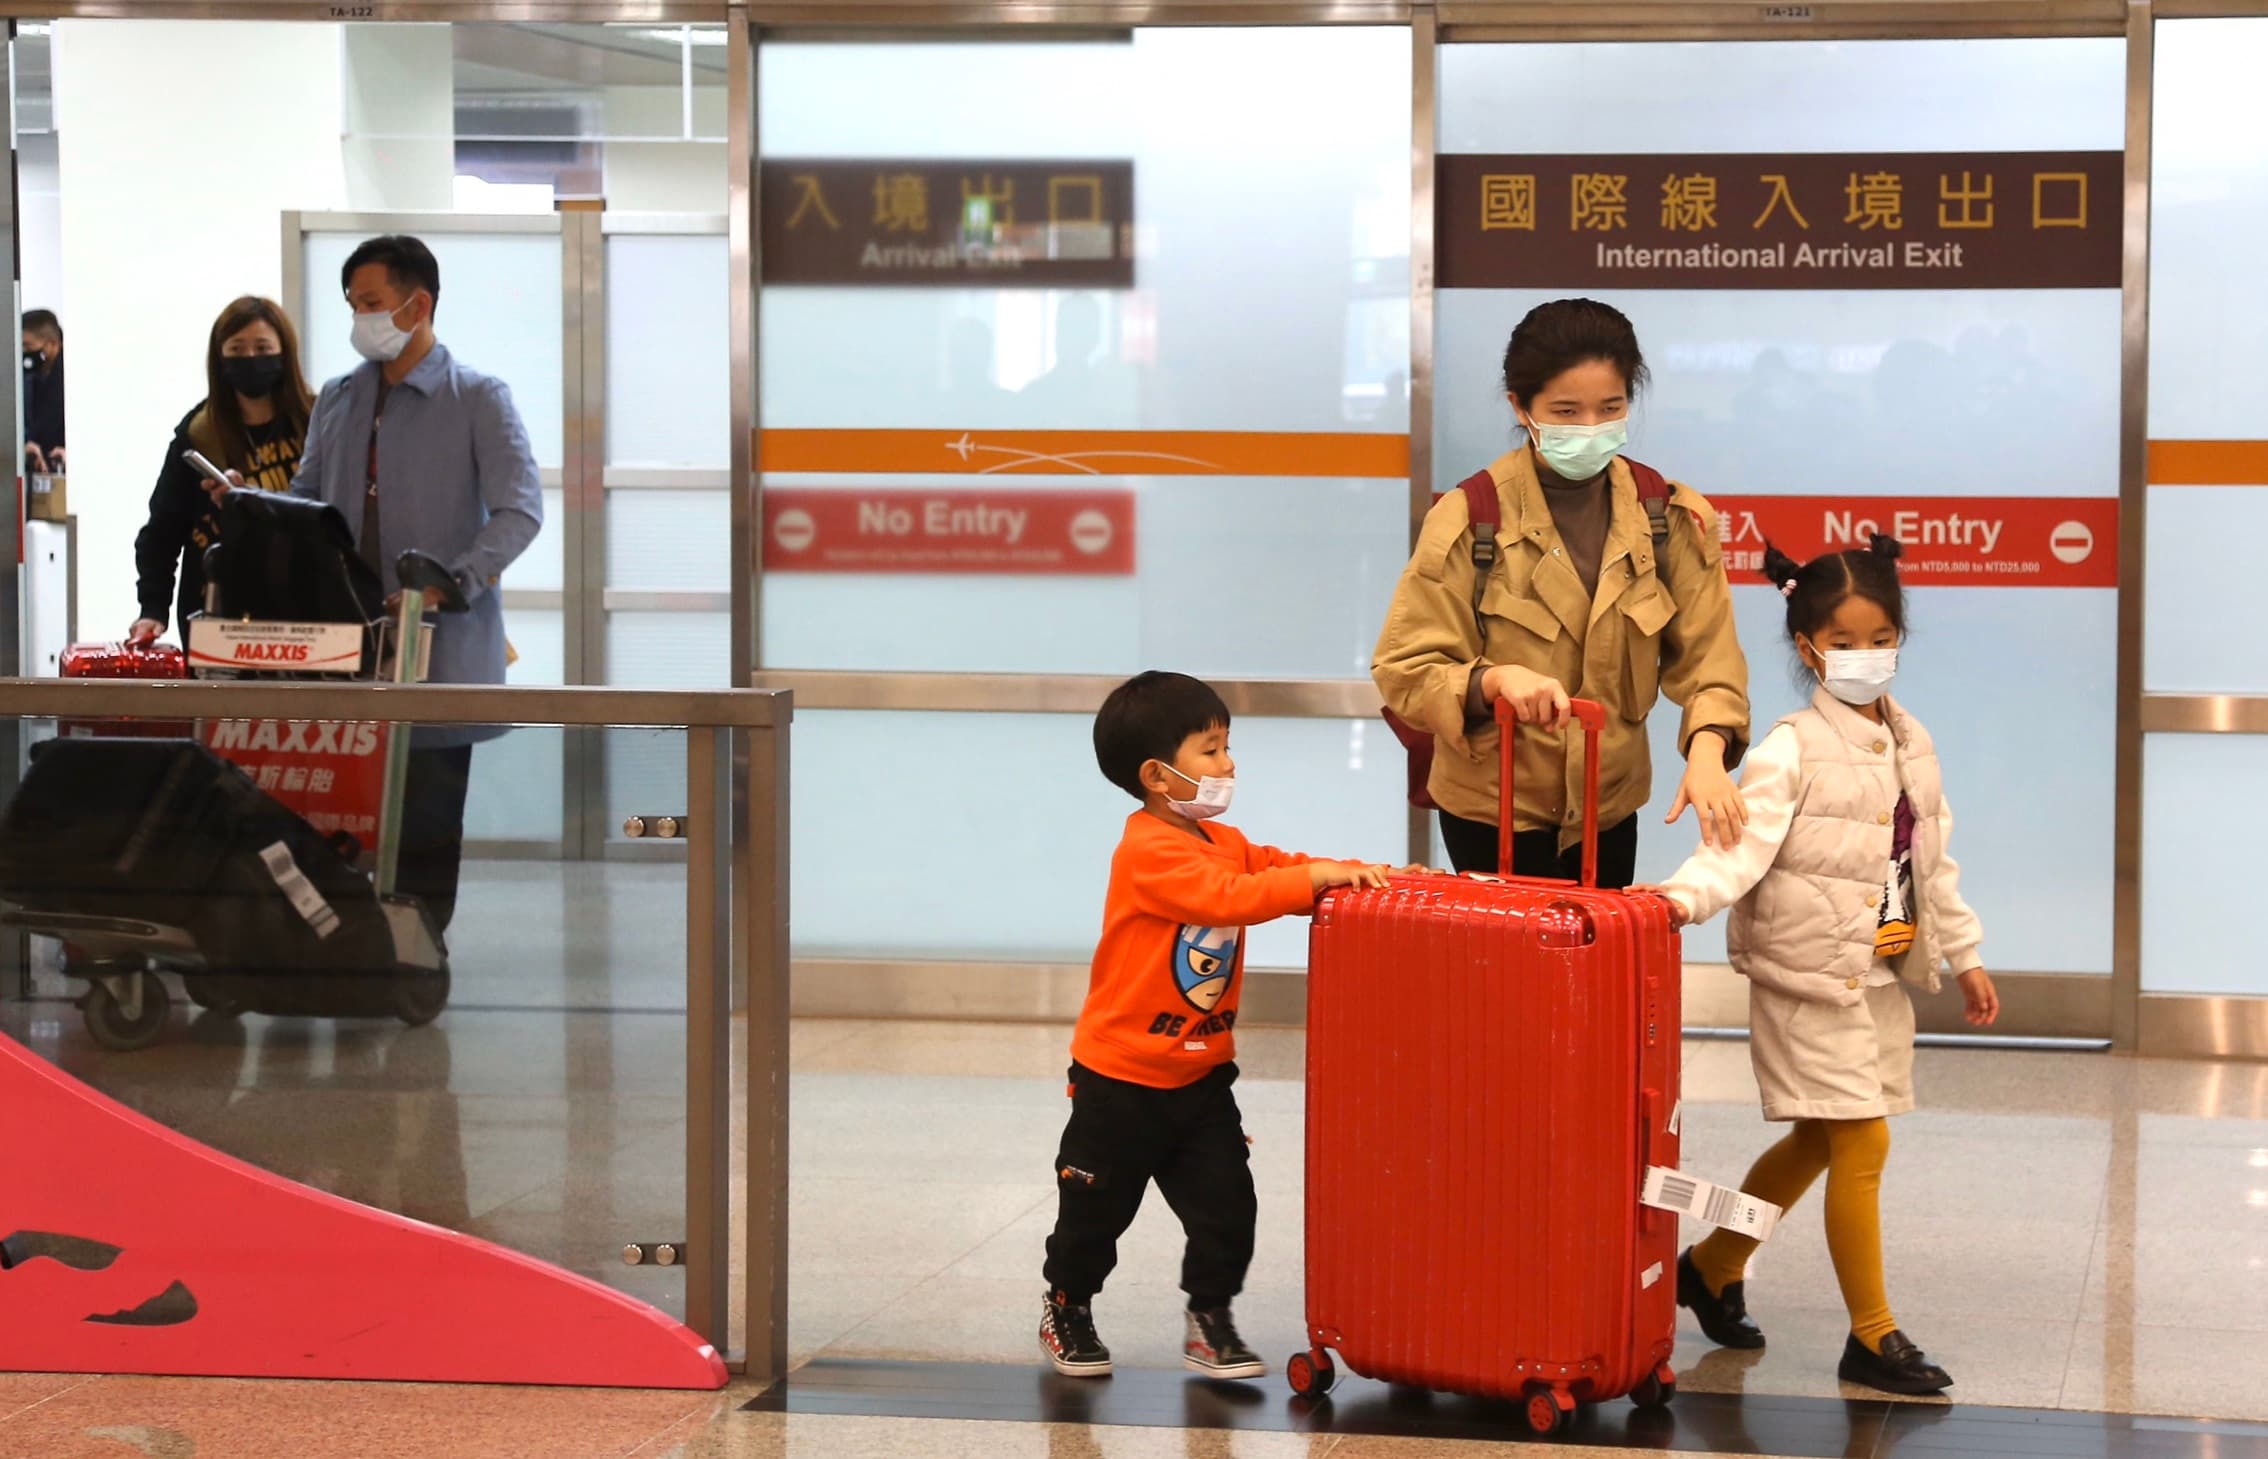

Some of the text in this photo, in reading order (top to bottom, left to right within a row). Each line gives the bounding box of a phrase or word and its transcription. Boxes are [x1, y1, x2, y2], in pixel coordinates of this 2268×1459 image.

[329, 7, 374, 17] TA-122
[784, 173, 1102, 232] 入境出口
[1480, 171, 2088, 231] 國際線入境出口
[859, 241, 956, 269] Arrival
[1596, 242, 1964, 268] International Arrival Exit
[858, 500, 1028, 544] No Entry
[1823, 510, 2004, 554] No Entry
[234, 643, 309, 662] MAXXIS
[209, 720, 379, 757] MAXXIS
[1147, 1011, 1188, 1037] BE
